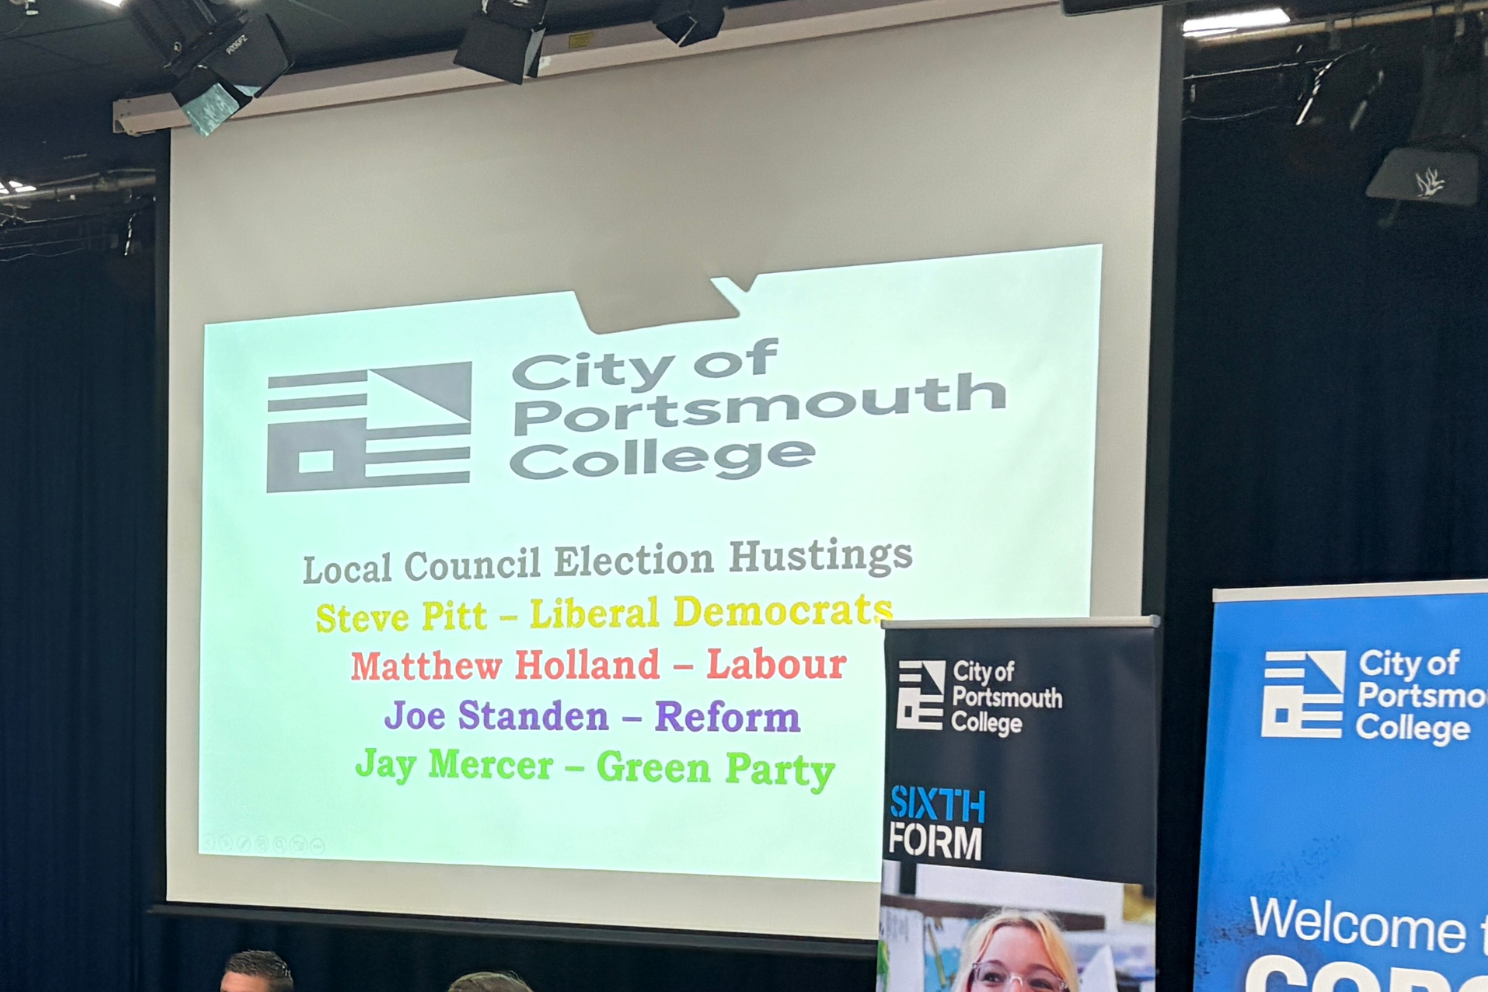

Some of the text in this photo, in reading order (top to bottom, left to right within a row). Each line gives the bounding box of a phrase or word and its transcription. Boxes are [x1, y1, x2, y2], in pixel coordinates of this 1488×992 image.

[512, 337, 779, 394] City of
[514, 372, 1006, 436] Portsmouth
[510, 438, 816, 480] College
[303, 536, 913, 584] Local Council Election Hustings
[316, 604, 409, 633] Steve
[422, 600, 488, 630] Pitt
[530, 595, 660, 629] Liberal
[674, 594, 894, 627] Democrats
[351, 650, 503, 681] Matthew
[515, 647, 660, 680] Holland
[707, 647, 848, 679] Labour
[953, 660, 1015, 686] City of
[1359, 648, 1461, 683] City of
[952, 685, 1063, 709] Portsmouth
[1358, 681, 1488, 708] Portsmo
[384, 700, 445, 730] Joe
[459, 699, 609, 731] Standen
[655, 699, 801, 732] Reform
[951, 710, 1023, 738] College
[1356, 712, 1471, 747] College
[355, 748, 417, 785] Jay
[429, 748, 554, 780] Mercer
[597, 750, 711, 783] Green
[725, 752, 836, 795] Party
[890, 785, 986, 824] SIXTH
[889, 821, 982, 861] FORM
[1250, 896, 1467, 954] Welcome
